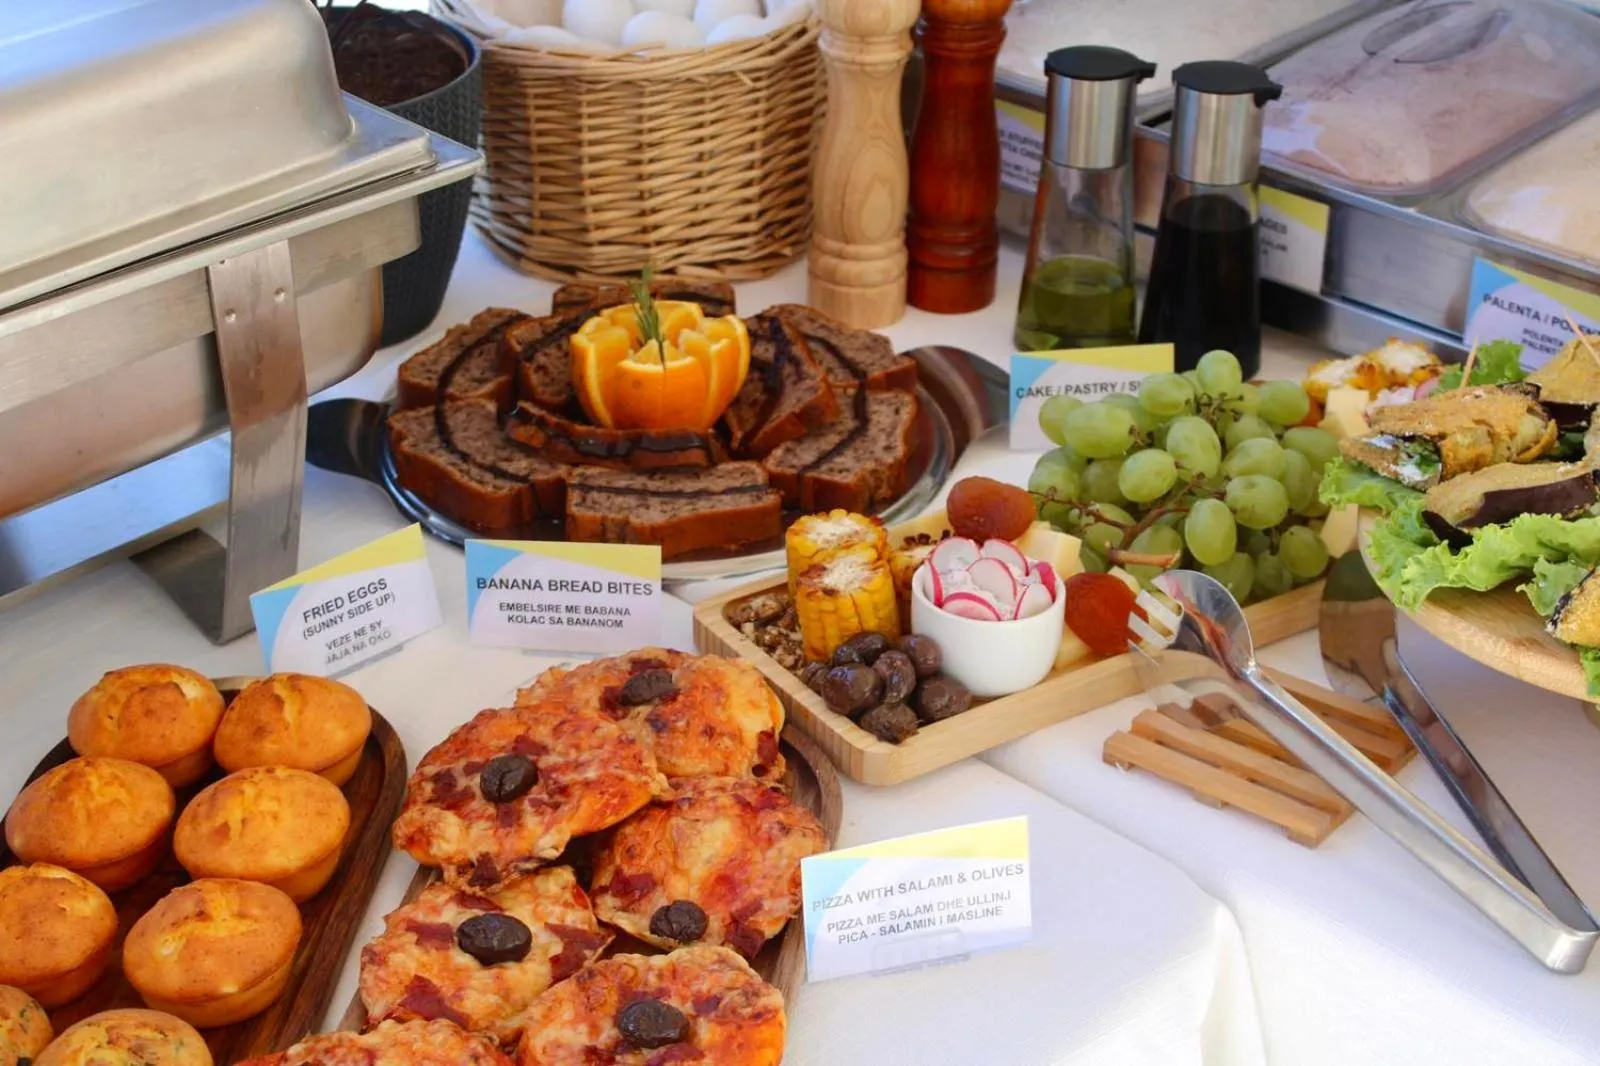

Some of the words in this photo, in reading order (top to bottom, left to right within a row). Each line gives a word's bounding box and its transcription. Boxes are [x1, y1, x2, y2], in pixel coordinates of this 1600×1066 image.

[1483, 293, 1541, 321] PALENTA
[1016, 386, 1053, 399] CAKE
[1064, 381, 1118, 396] PASTRY
[303, 596, 345, 624] FRIED
[347, 577, 388, 604] EGGS
[476, 577, 543, 592] BANANA
[548, 579, 603, 594] BREAD
[607, 581, 653, 596] BITES
[303, 612, 345, 640] (SUNNY
[347, 600, 374, 620] SIDE
[375, 592, 396, 607] UP)
[499, 602, 562, 614] EMBELSIRE
[564, 604, 581, 615] ME
[584, 605, 632, 617] BABANA
[507, 614, 546, 625] KOLAC
[549, 616, 564, 626] SA
[566, 617, 624, 629] BANANOM
[326, 633, 352, 651] VEZE
[353, 626, 368, 639] NE
[369, 619, 383, 632] SY
[326, 648, 351, 664] JAJA
[811, 893, 853, 913] PIZZA
[856, 885, 895, 904] WITH
[898, 873, 953, 895] SALAMI
[956, 871, 968, 884] &
[971, 863, 1025, 882] OLIVES
[827, 916, 864, 933] PIZZA
[866, 912, 887, 926] ME
[889, 903, 934, 921] SALAM
[937, 897, 965, 912] DHE
[838, 928, 869, 945] PICA
[879, 917, 936, 937] SALAMIN
[946, 905, 1004, 925] MASLINE
